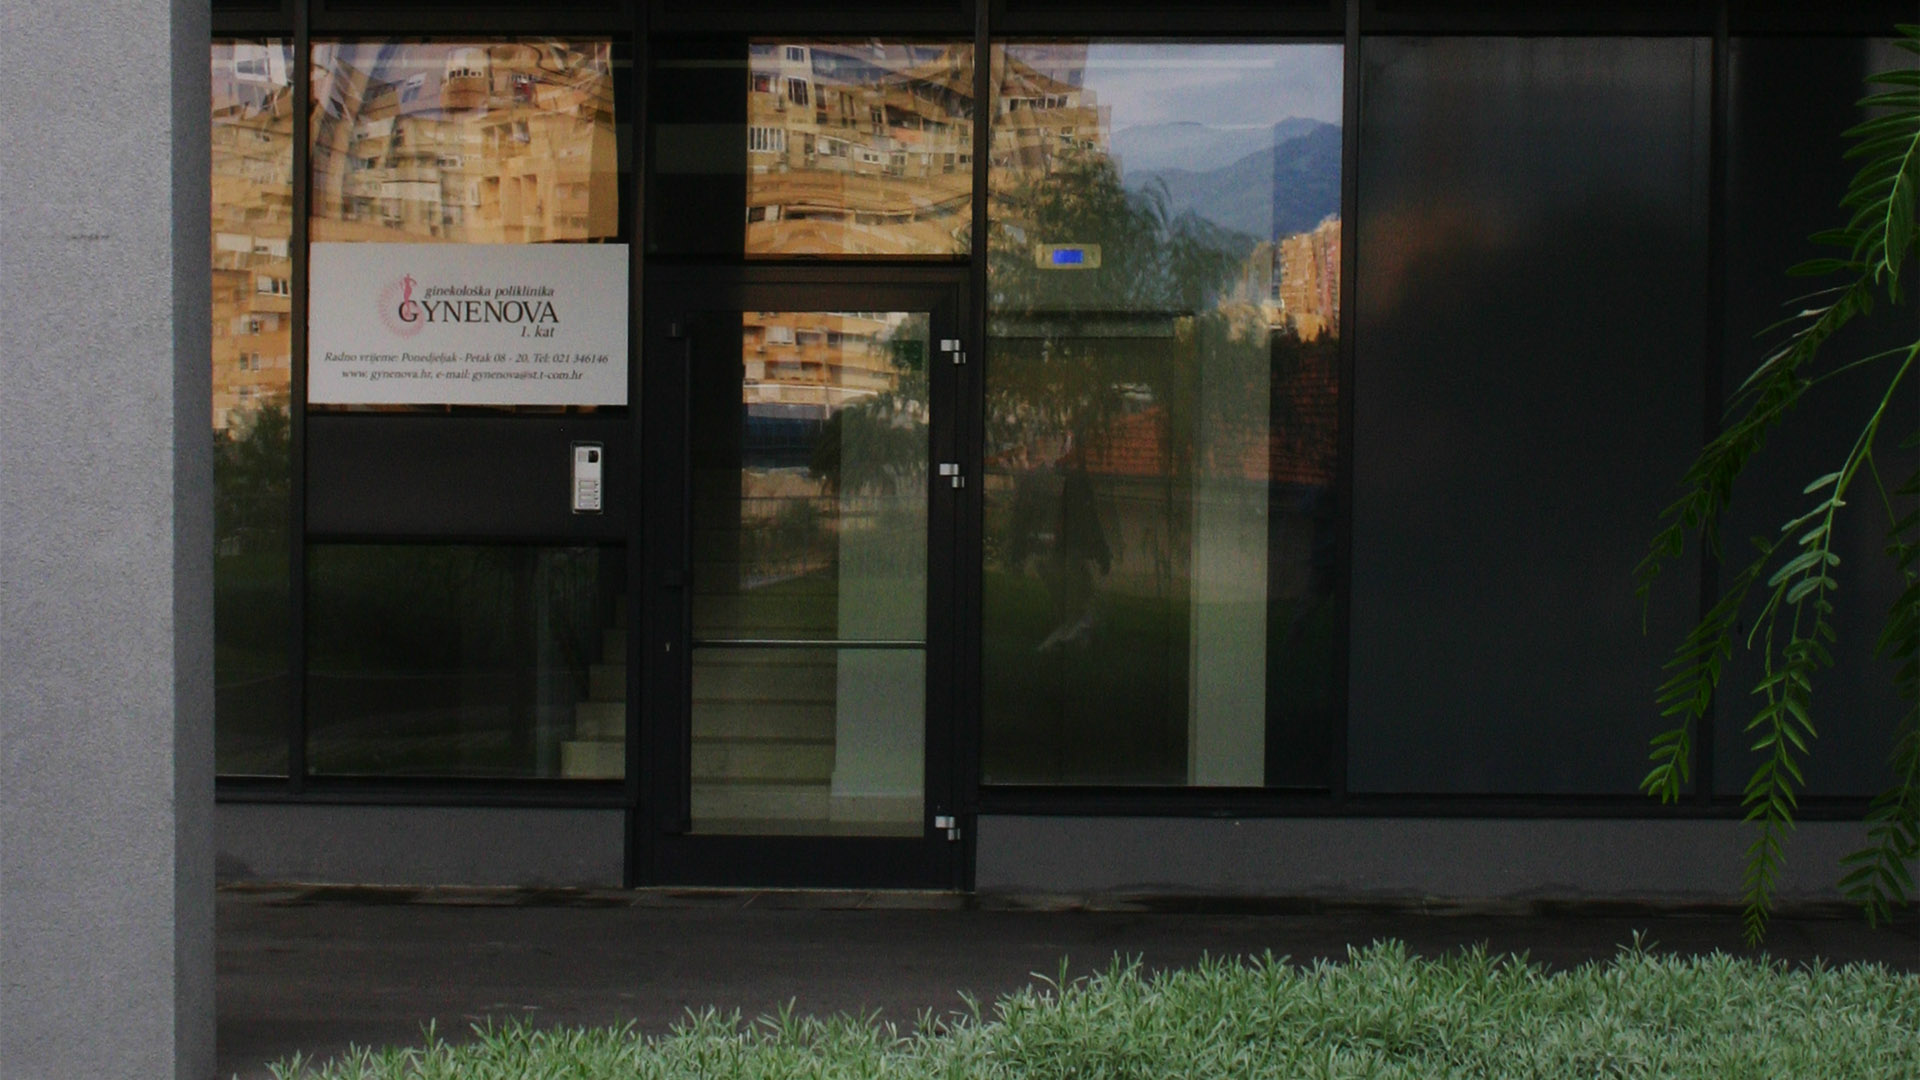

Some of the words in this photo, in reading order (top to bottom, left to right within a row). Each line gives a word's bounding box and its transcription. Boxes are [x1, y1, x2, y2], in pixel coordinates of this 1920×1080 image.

[425, 285, 491, 299] ginekološka
[495, 285, 555, 299] poliklinika
[398, 300, 560, 323] GYNENOVA
[521, 326, 531, 338] 1.
[534, 325, 555, 338] kat
[324, 351, 357, 362] Radno
[401, 351, 457, 364] Ponedjeljak
[464, 352, 490, 363] Petak
[493, 353, 506, 363] 08
[552, 353, 570, 363] 021
[573, 353, 609, 364] 346146
